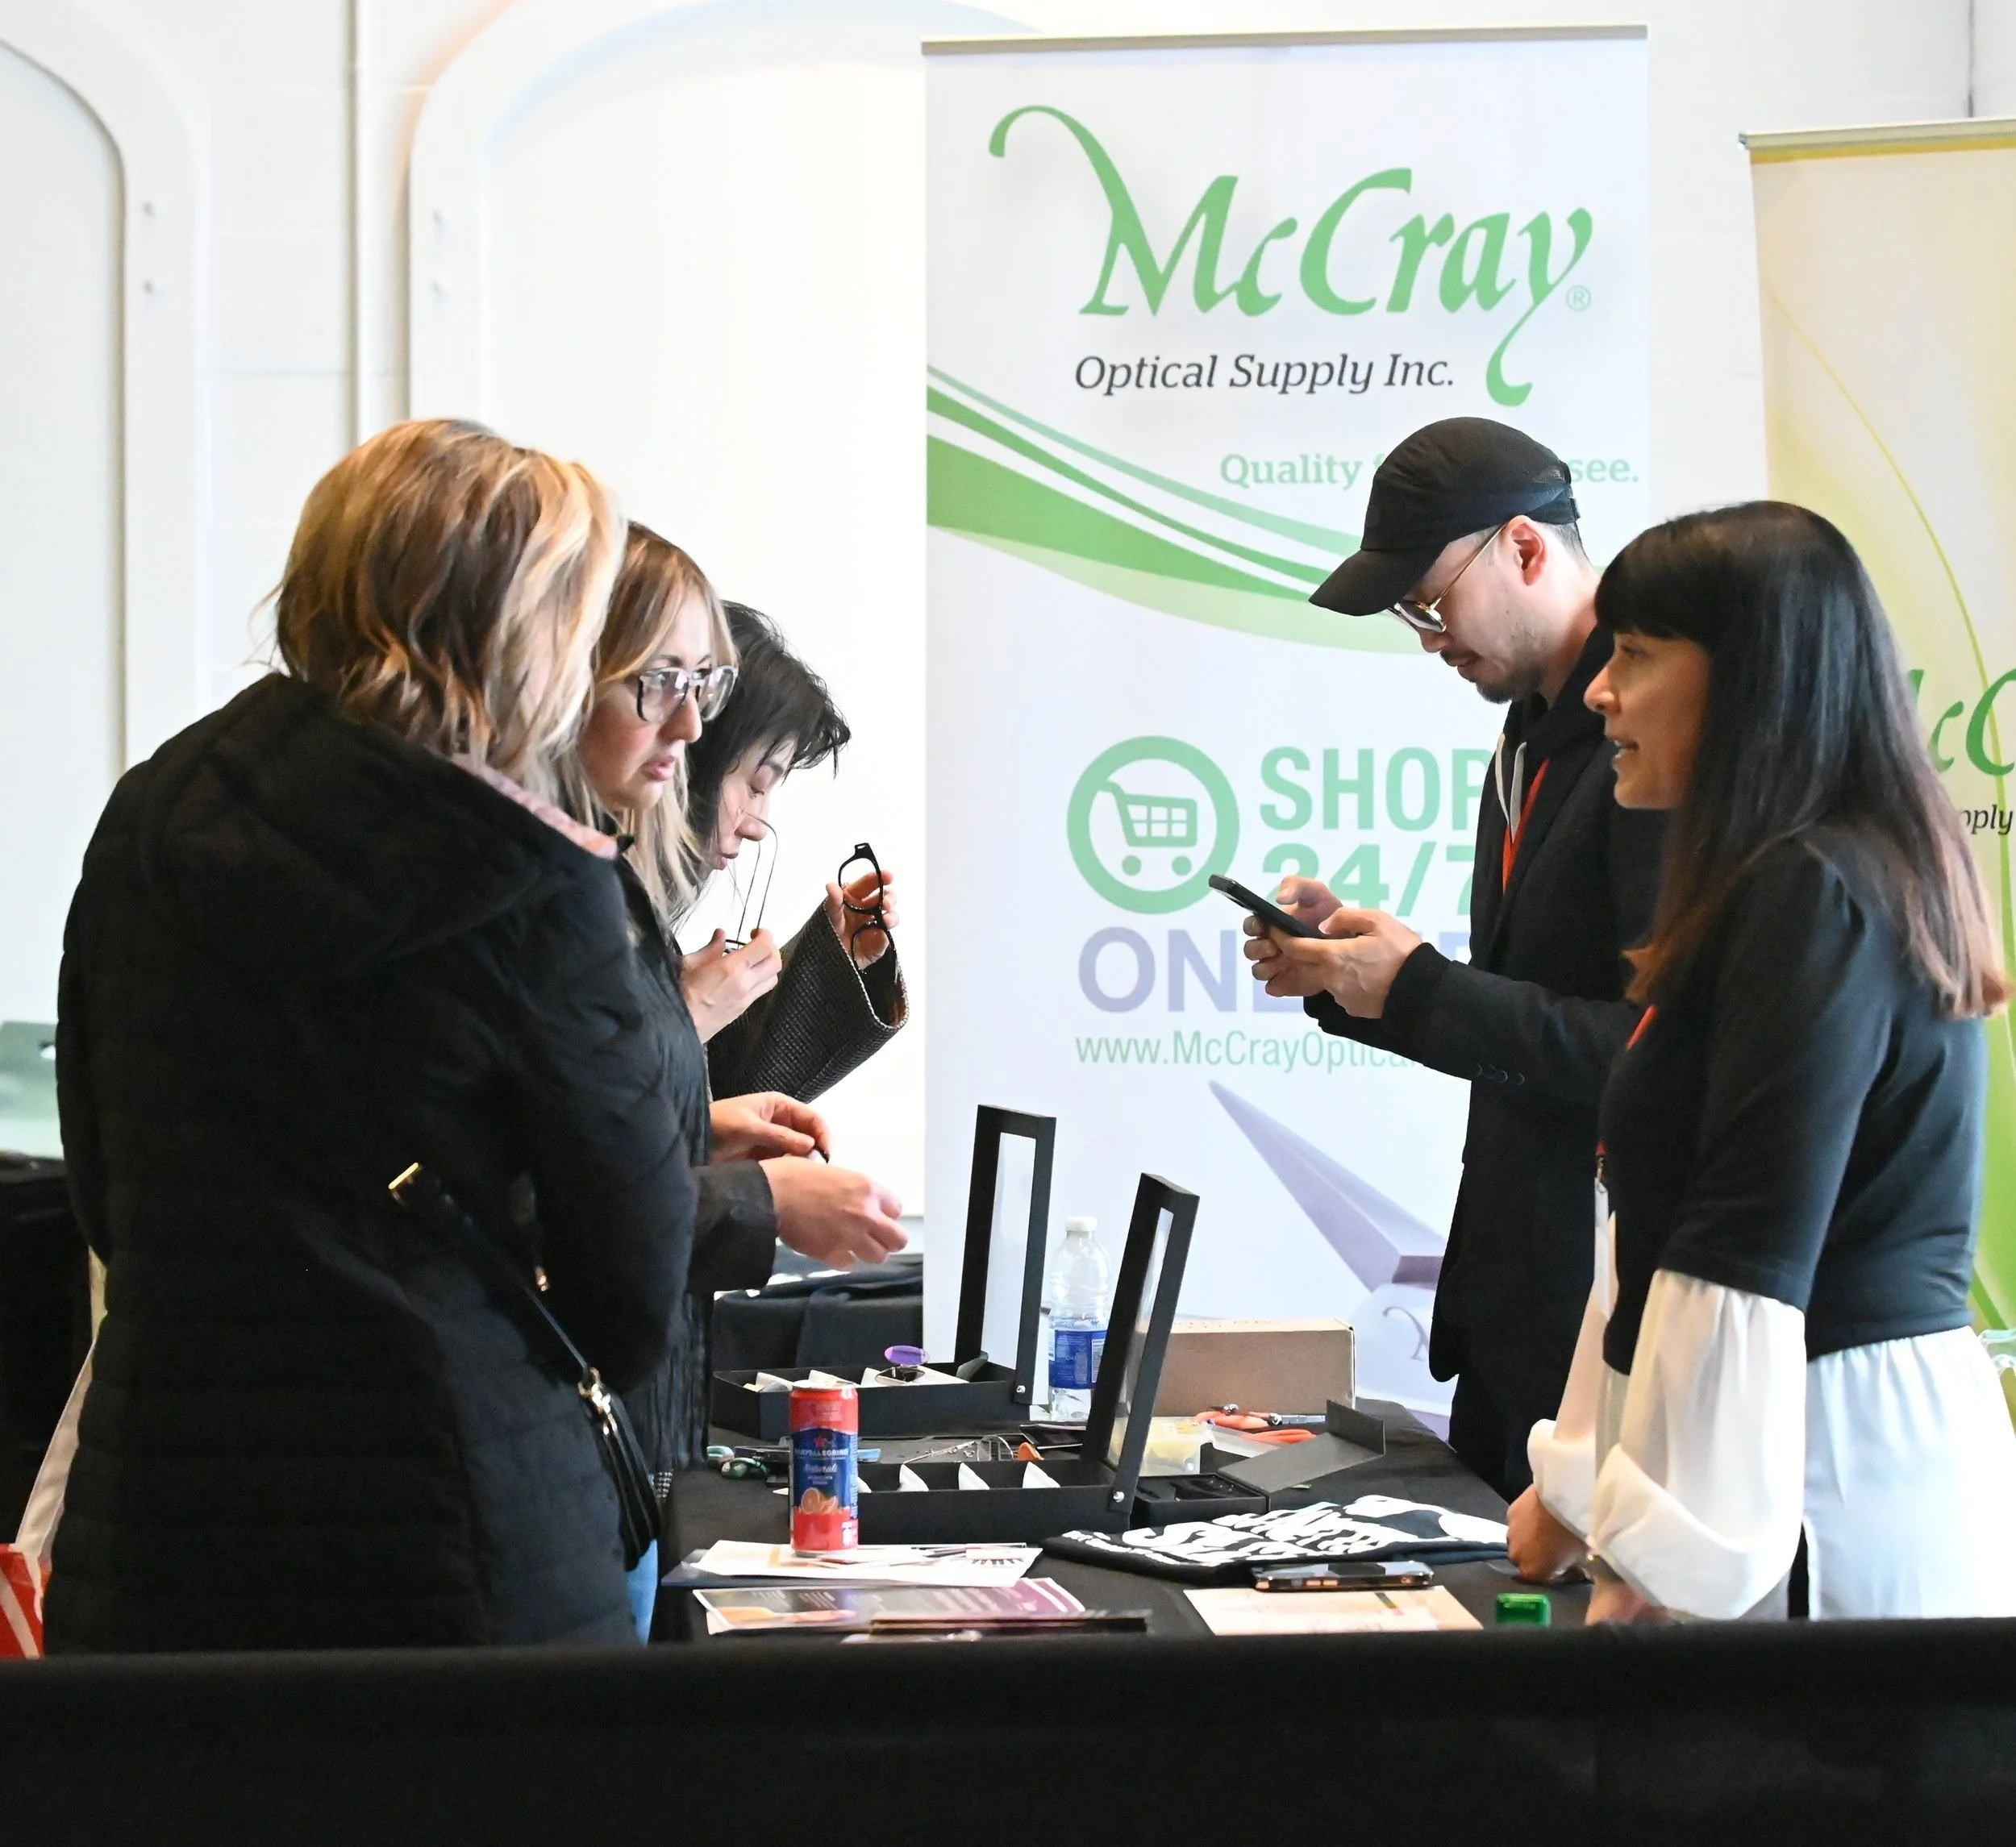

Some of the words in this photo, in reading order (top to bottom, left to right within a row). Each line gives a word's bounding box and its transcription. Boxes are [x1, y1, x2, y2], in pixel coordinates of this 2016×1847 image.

[1075, 355, 1218, 396] Optical
[1230, 354, 1374, 393] Supply
[1384, 353, 1455, 387] Inc.
[1220, 453, 1362, 490] Quality
[1260, 747, 1493, 831] SHOP
